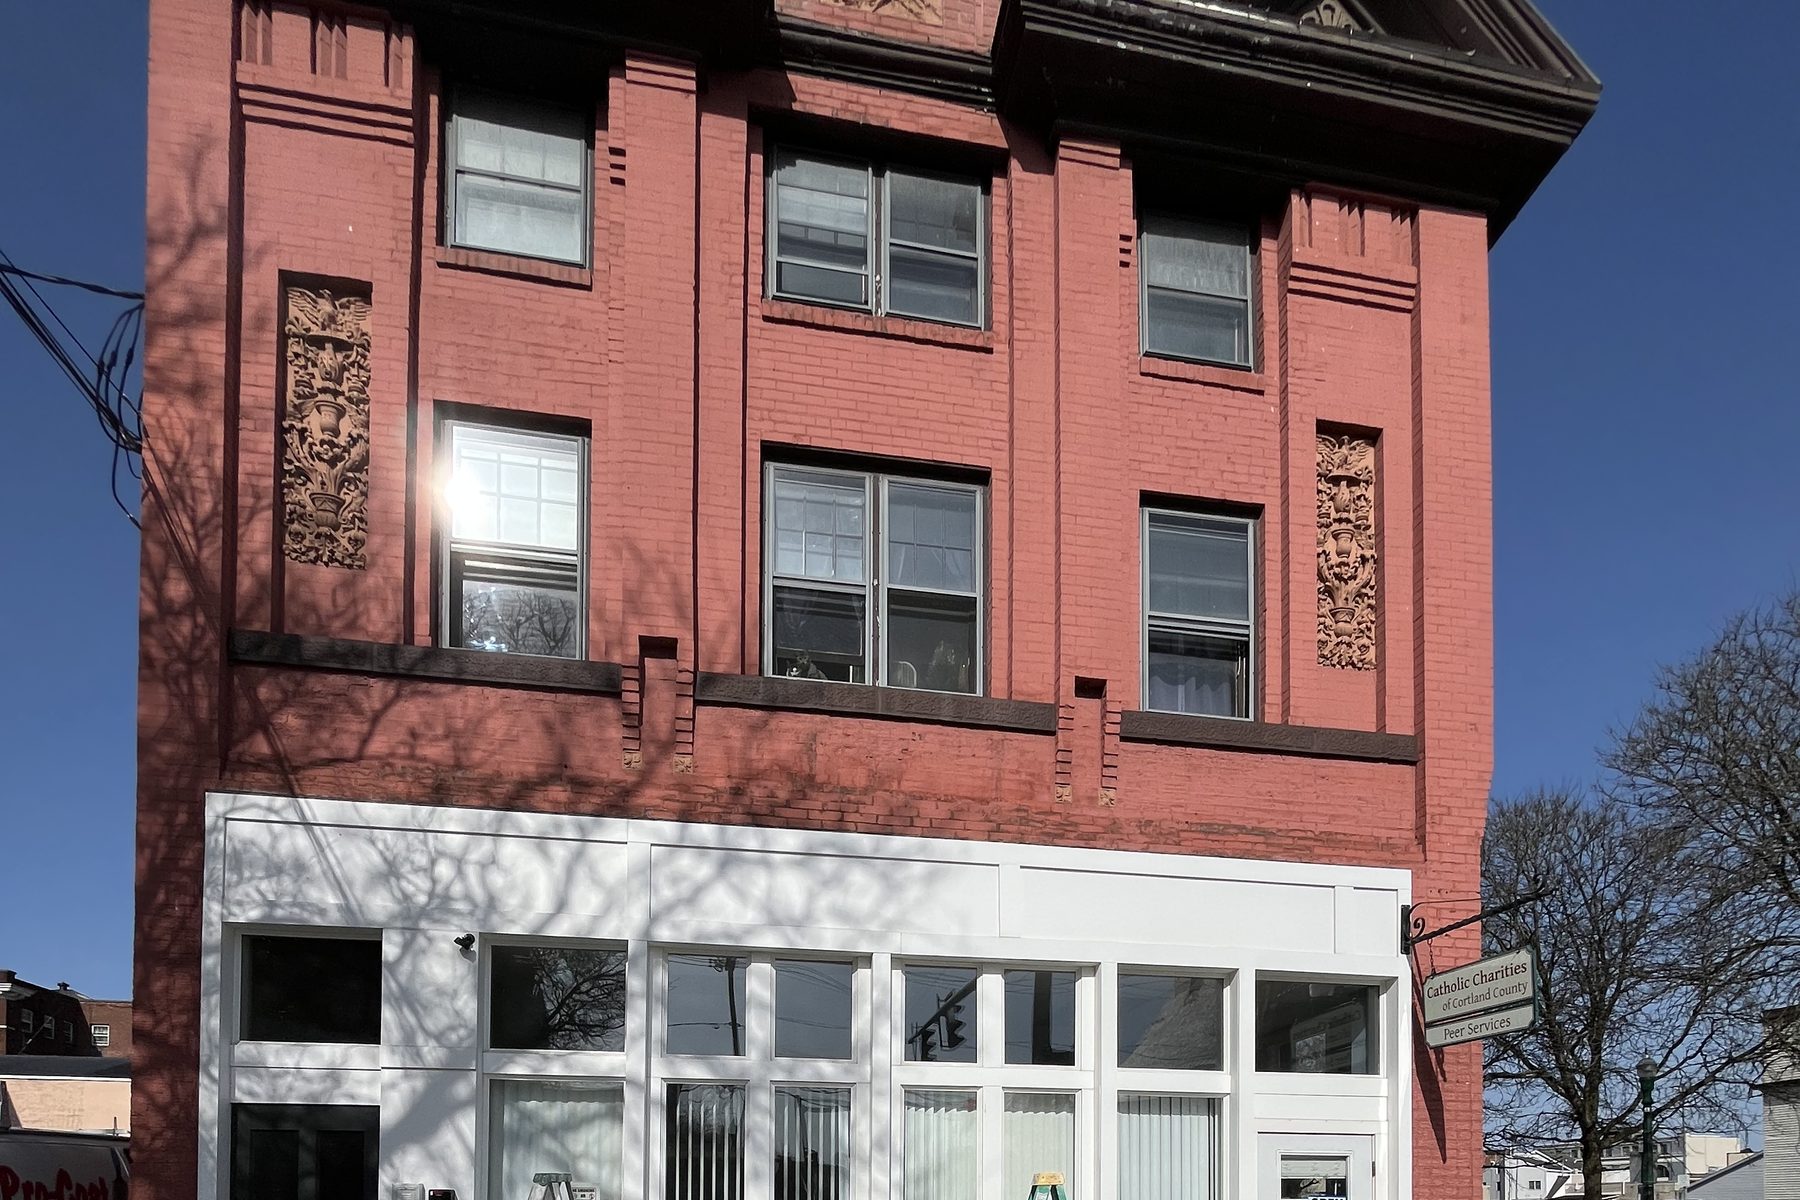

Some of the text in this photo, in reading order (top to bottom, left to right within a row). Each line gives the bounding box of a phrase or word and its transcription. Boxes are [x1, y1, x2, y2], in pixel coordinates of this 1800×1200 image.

[1427, 962, 1527, 998] Catholic Charities
[1442, 982, 1528, 1011] of Cortland County
[1444, 1017, 1511, 1040] Peer Services
